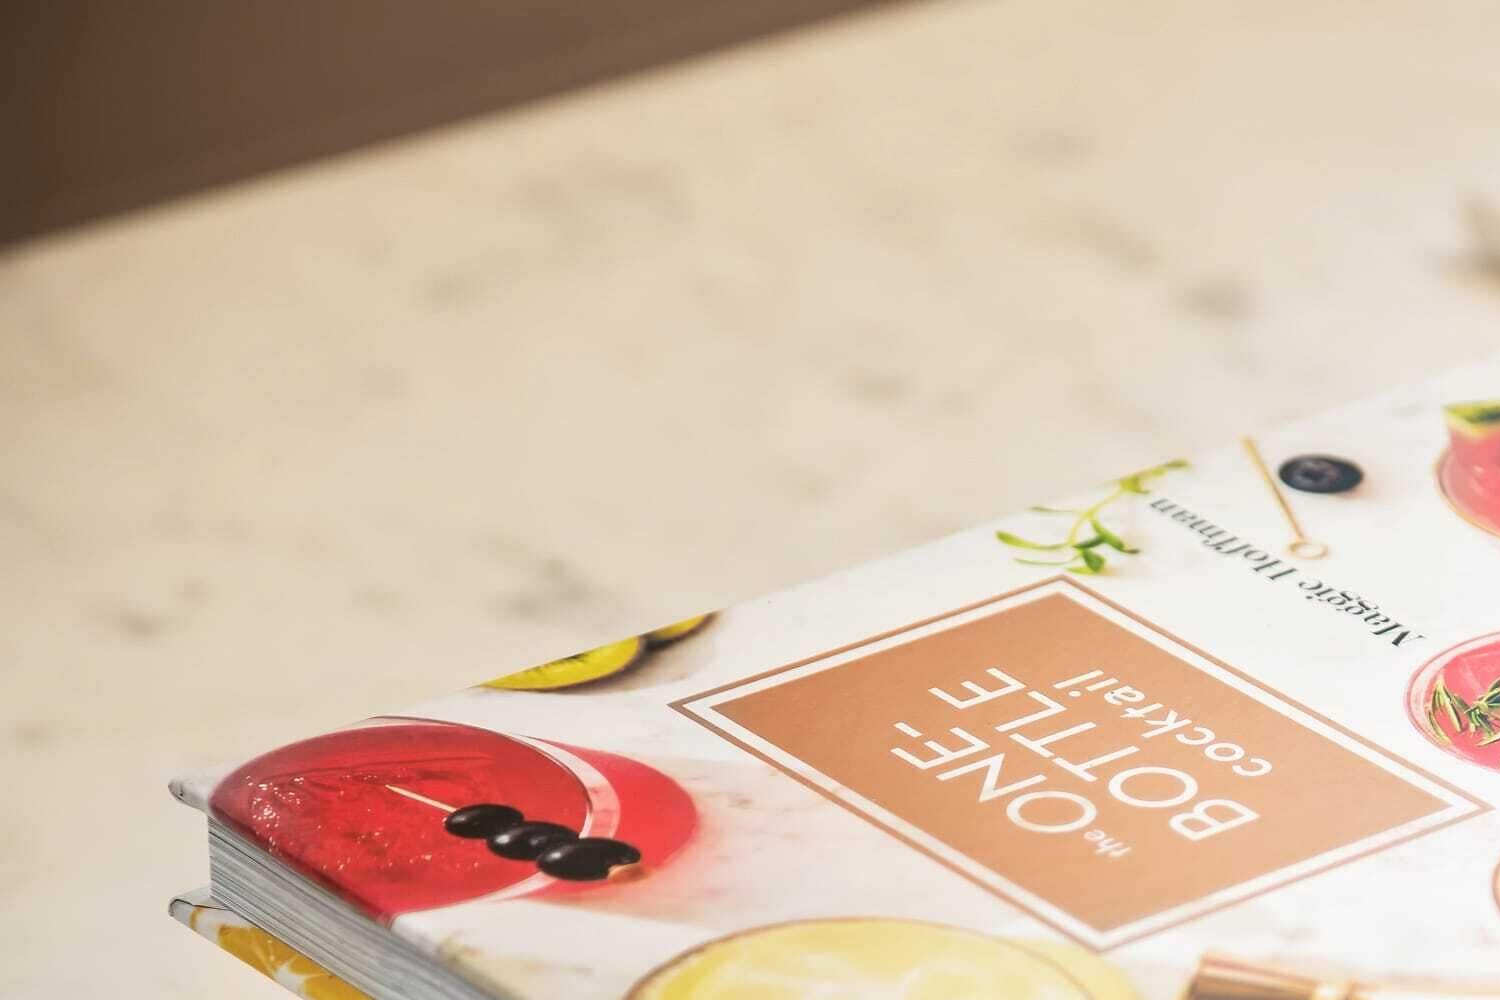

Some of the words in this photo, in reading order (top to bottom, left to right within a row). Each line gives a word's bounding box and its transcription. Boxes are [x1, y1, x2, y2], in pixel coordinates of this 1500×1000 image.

[1150, 498, 1297, 580] Hoffman
[1298, 578, 1426, 648] Maggie
[928, 667, 1261, 842] BOTTLE
[1053, 669, 1273, 777] cocktail
[890, 721, 1098, 834] ONE-
[1084, 829, 1132, 858] the
